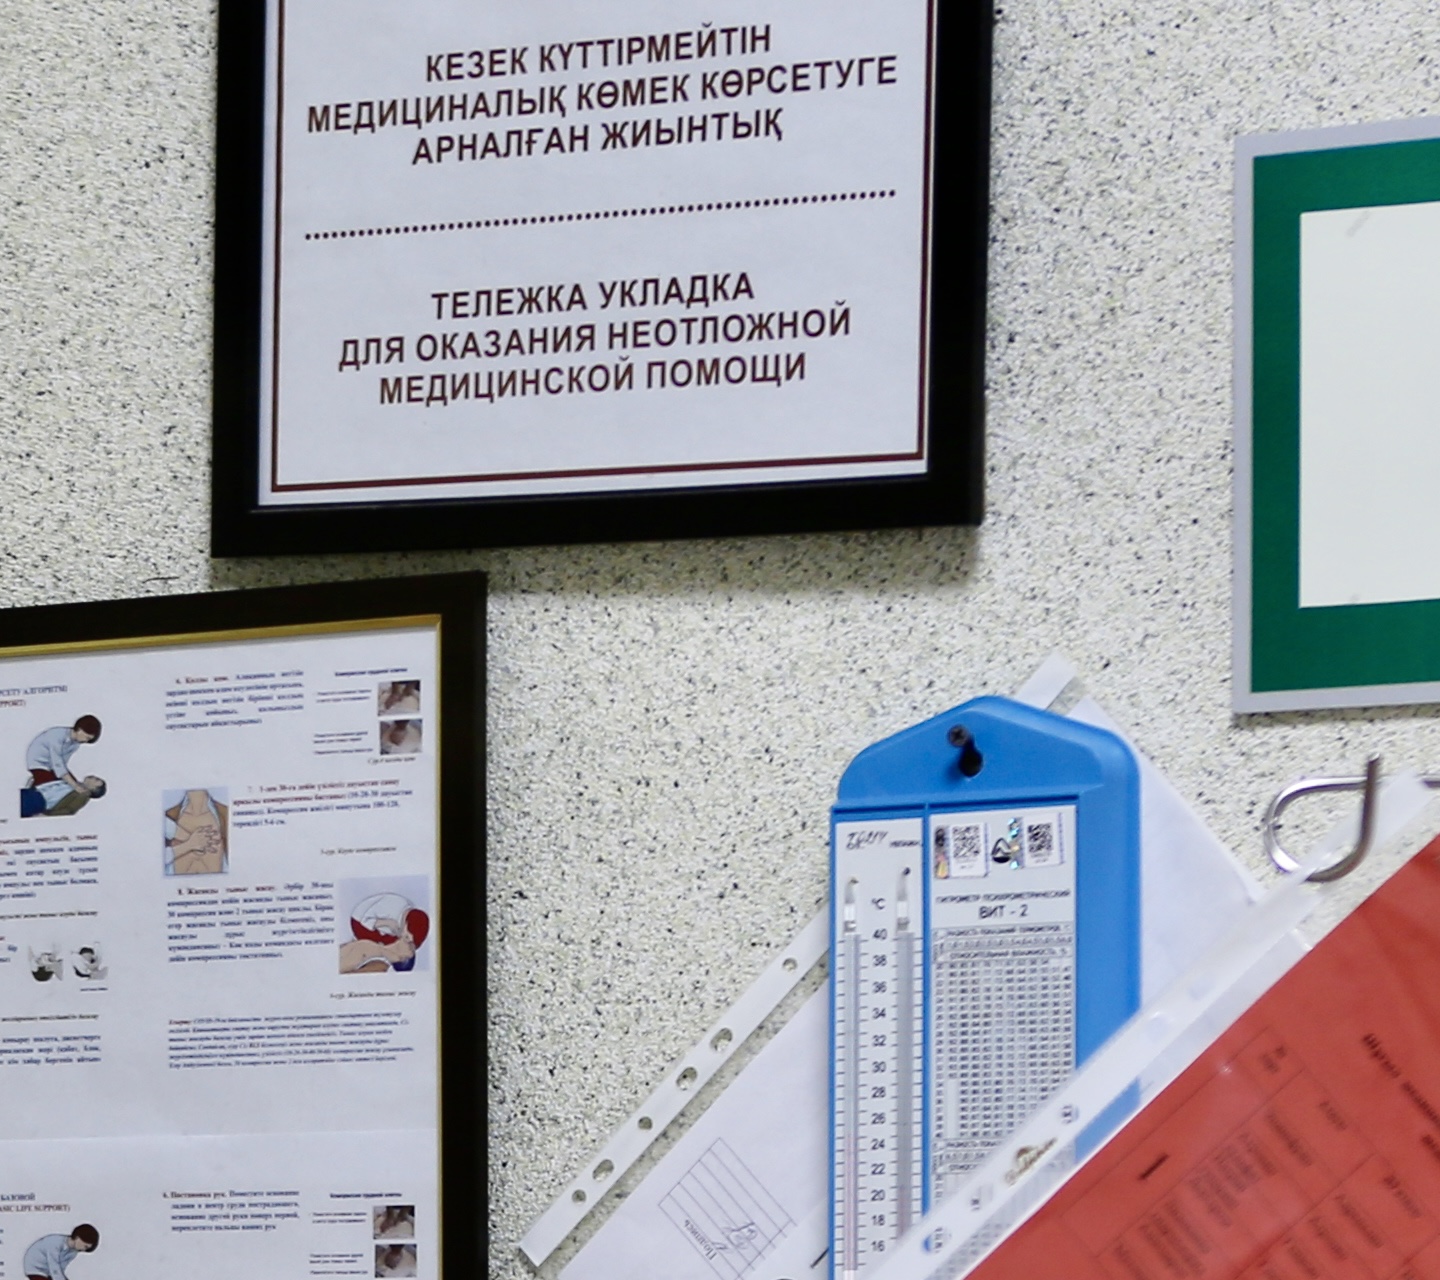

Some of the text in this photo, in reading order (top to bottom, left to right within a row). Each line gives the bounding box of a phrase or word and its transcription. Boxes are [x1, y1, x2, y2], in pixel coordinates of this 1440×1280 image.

[426, 21, 771, 82] КЕЗЕК КҮТТІРМЕЙТІН
[307, 55, 898, 135] МЕДИЦИНАЛЫҚ КӨМЕК КӨРСЕТУГЕ
[412, 107, 783, 165] АРНАЛҒАН ЖИЫНТЫҚ
[431, 272, 755, 321] ТЕЛЕЖКА УКЛАДКА
[338, 299, 851, 372] ДЛЯ ОКАЗАНИЯ НЕОТЛОЖНОЙ
[379, 352, 807, 407] МЕДИЦИНСКОЙ ПОМОЩИ
[979, 905, 1005, 919] ВИТ
[1020, 904, 1029, 917] 2
[871, 928, 887, 940] 40
[871, 955, 887, 966] 38
[871, 981, 887, 993] 36
[871, 1008, 887, 1019] 34
[871, 1035, 887, 1046] 32
[871, 1062, 887, 1073] 30
[871, 1087, 887, 1098] 28
[871, 1113, 887, 1124] 26
[871, 1139, 887, 1150] 24
[871, 1164, 887, 1175] 22
[871, 1189, 887, 1201] 20
[871, 1215, 887, 1226] 18
[683, 1219, 717, 1261] Подпись
[871, 1240, 887, 1252] 16
